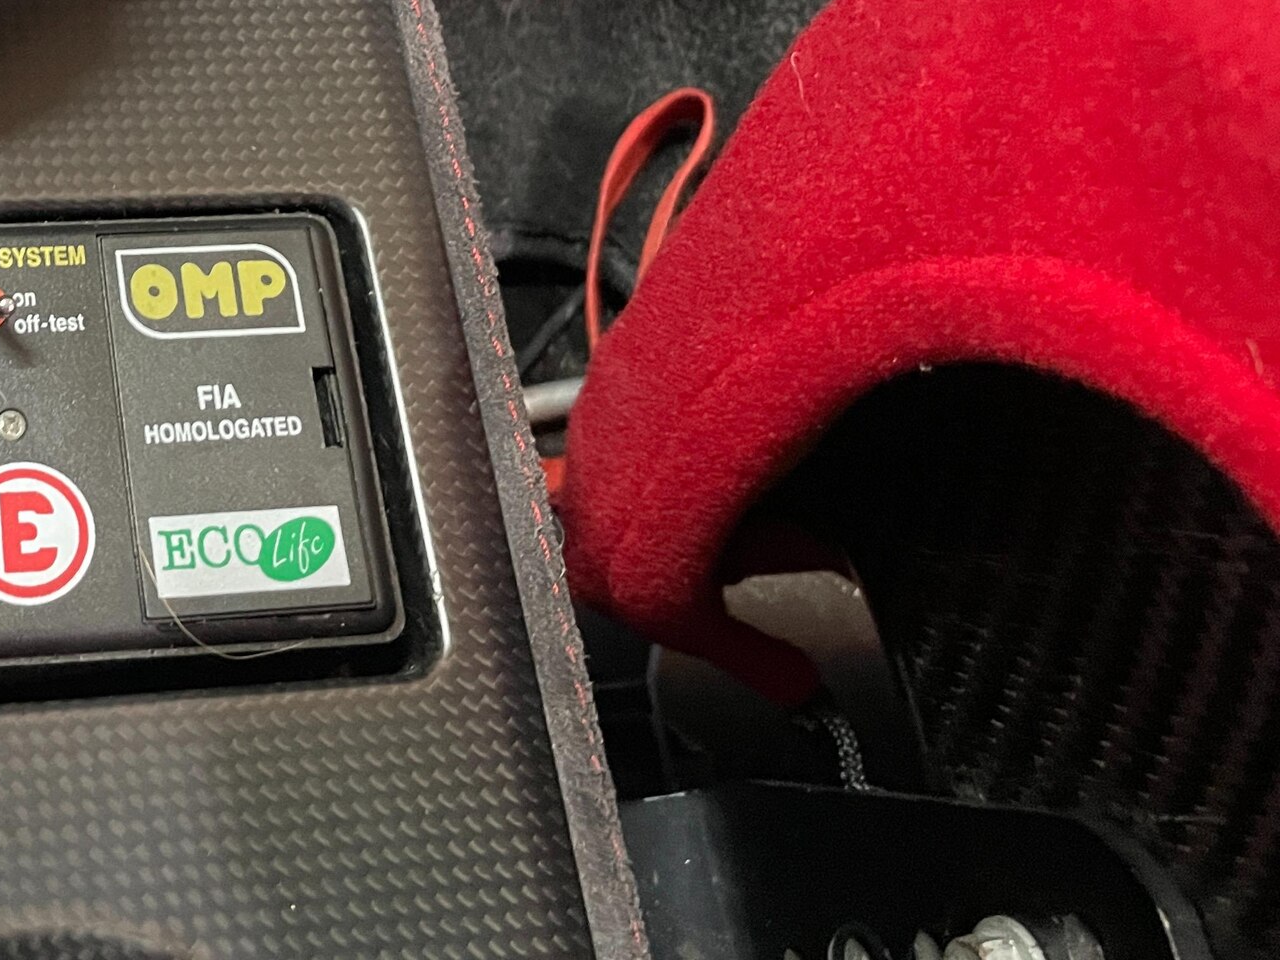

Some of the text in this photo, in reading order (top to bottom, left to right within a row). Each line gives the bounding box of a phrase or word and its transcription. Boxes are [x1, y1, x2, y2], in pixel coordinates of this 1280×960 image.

[130, 260, 286, 319] OMP
[14, 313, 85, 334] off-test
[196, 383, 242, 410] FIA
[144, 416, 303, 444] HOMOLOGATED
[0, 491, 58, 573] E
[158, 523, 266, 570] ECO
